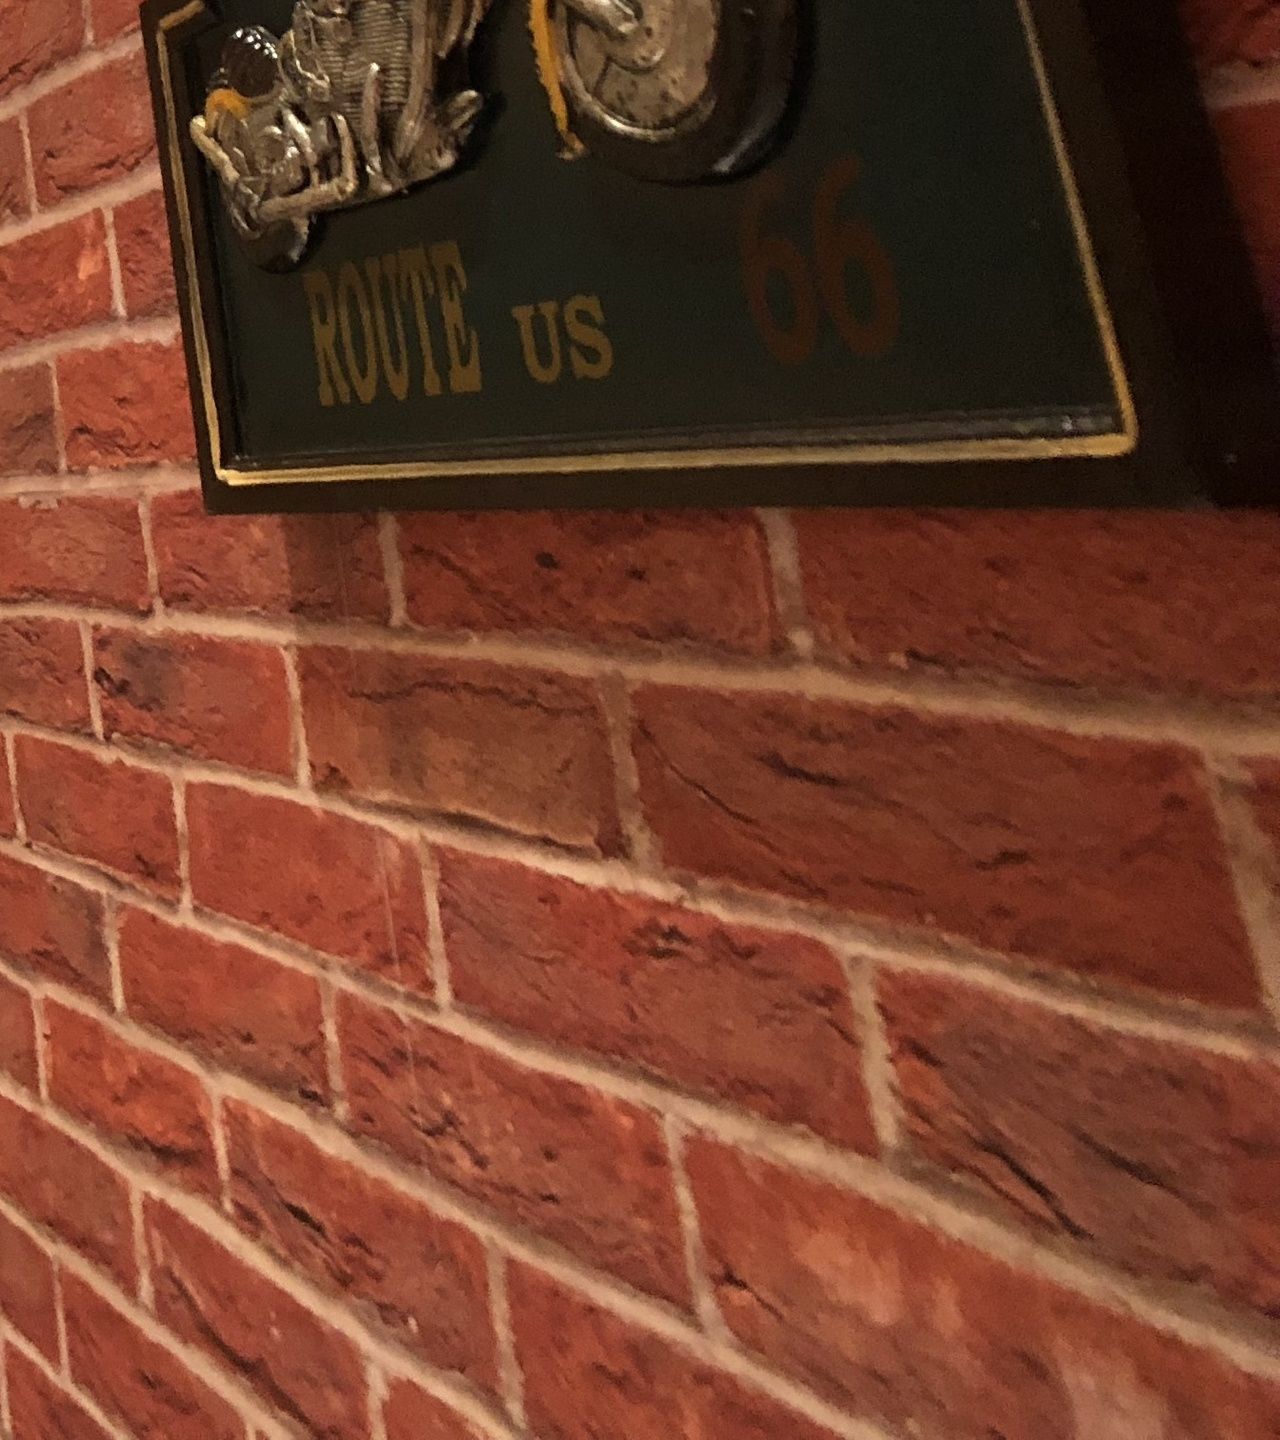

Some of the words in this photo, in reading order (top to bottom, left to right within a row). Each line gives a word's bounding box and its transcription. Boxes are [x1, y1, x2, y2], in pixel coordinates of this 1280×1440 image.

[303, 239, 482, 408] ROUTE
[513, 294, 614, 384] US
[742, 152, 900, 365] 66
